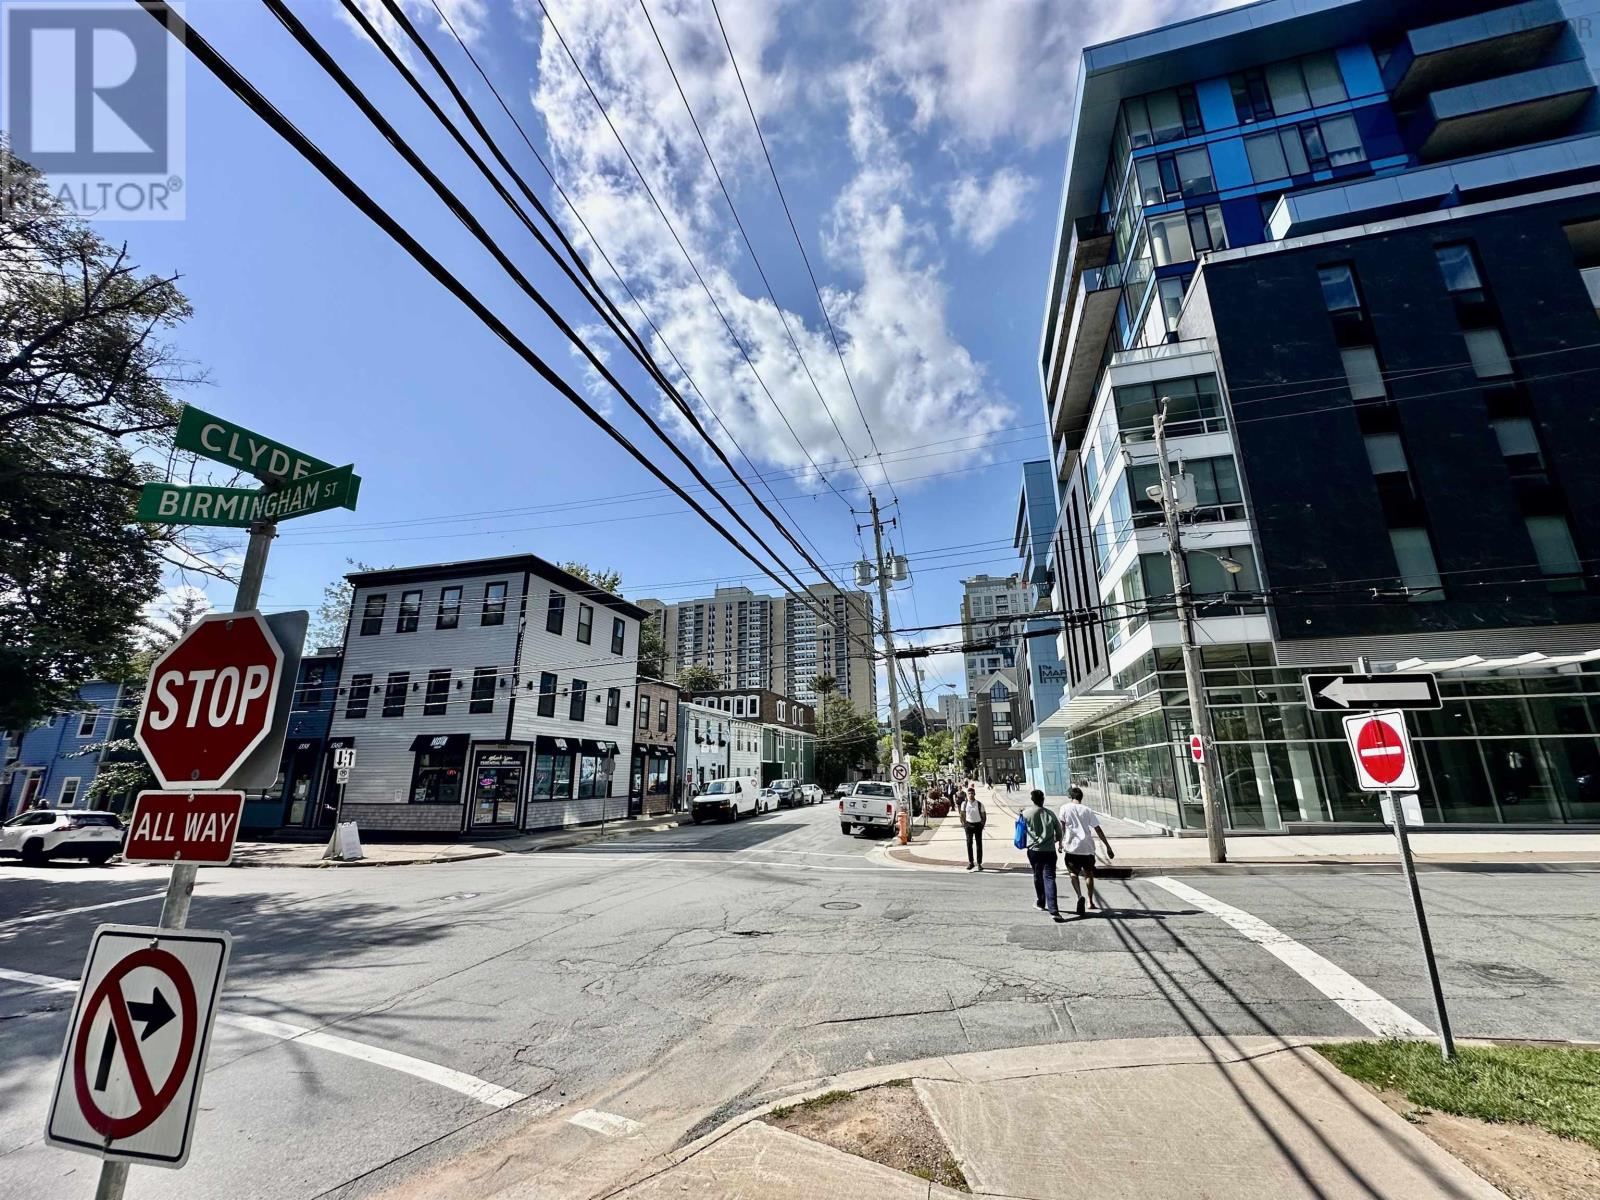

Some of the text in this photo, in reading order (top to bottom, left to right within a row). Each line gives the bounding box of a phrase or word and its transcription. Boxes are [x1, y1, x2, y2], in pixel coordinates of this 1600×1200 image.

[158, 481, 339, 520] BIRMINGHAM ST
[150, 664, 270, 731] STOP
[133, 812, 235, 843] ALL WAY
